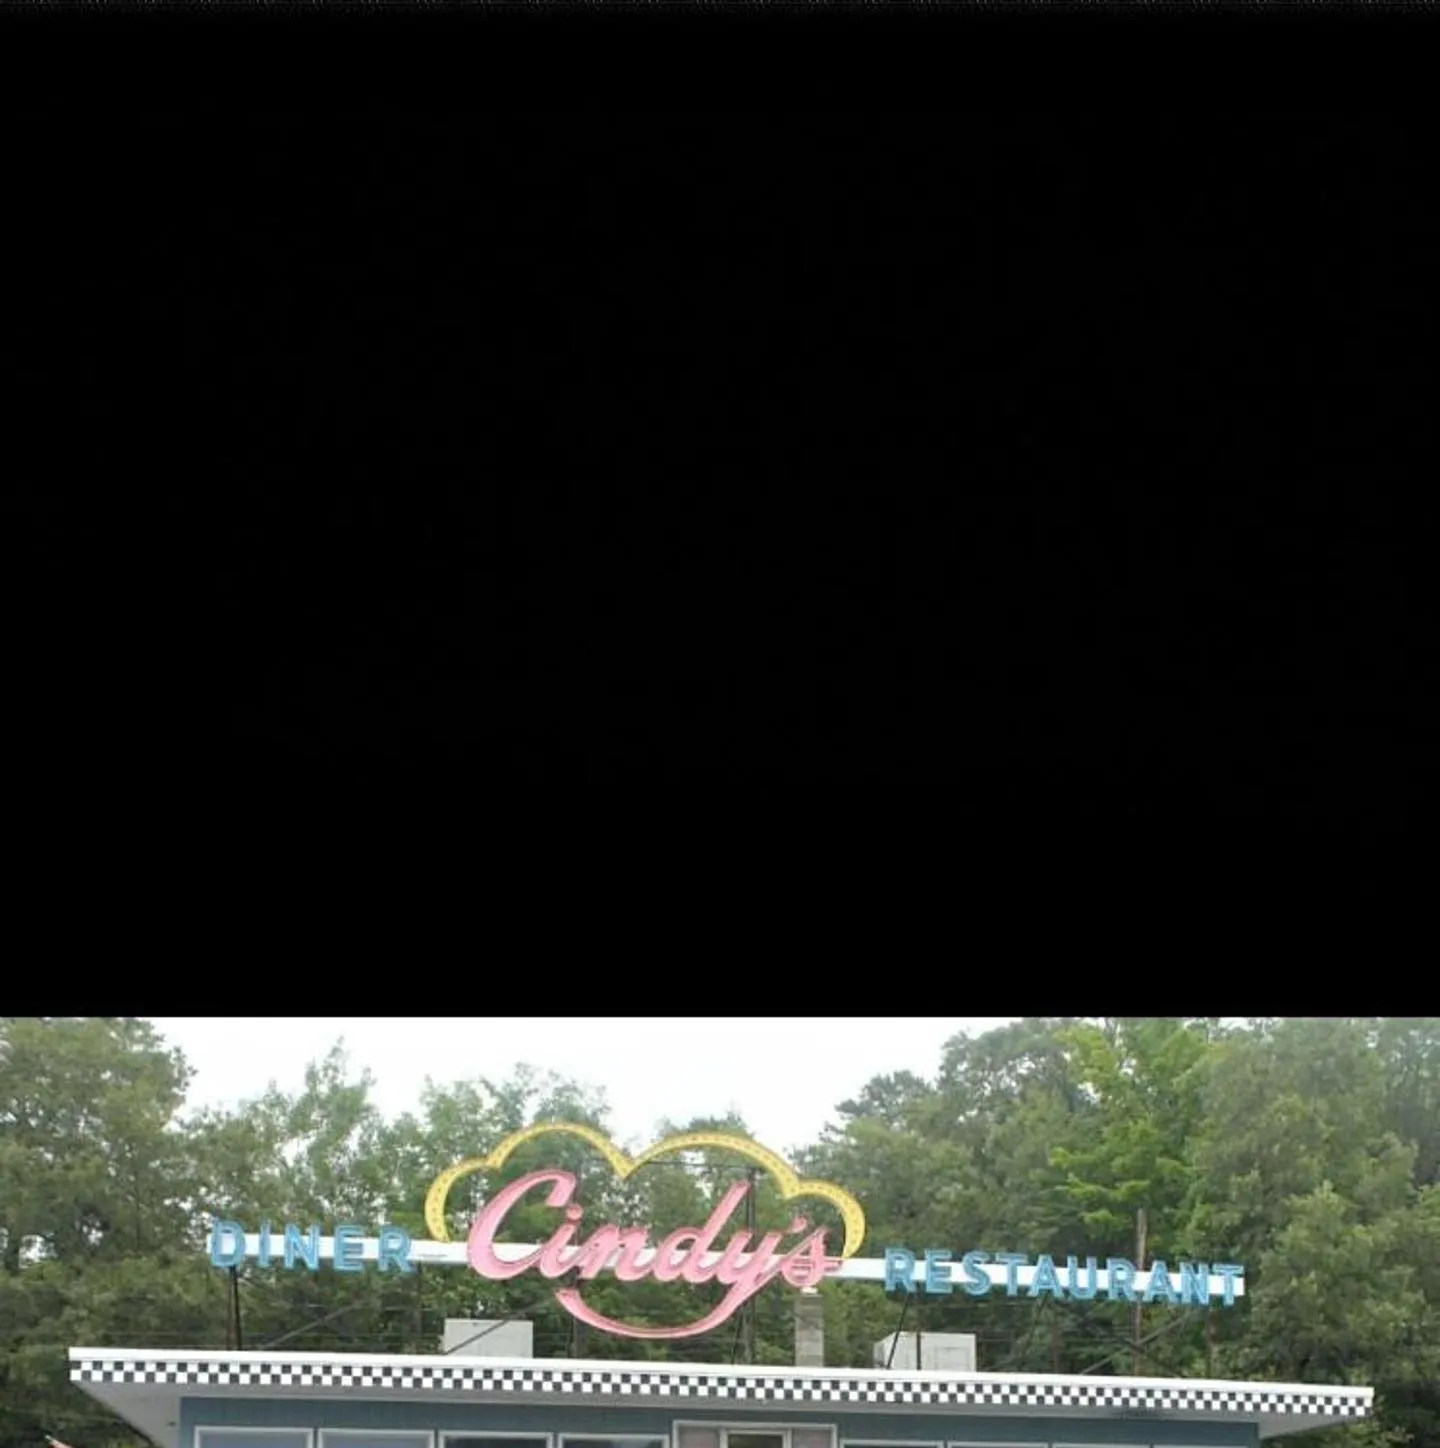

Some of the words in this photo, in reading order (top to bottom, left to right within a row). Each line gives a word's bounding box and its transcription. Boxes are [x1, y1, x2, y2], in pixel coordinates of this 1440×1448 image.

[210, 1220, 415, 1273] DINER
[466, 1168, 845, 1337] Cindy's
[884, 1246, 1244, 1306] RESTAURANT
